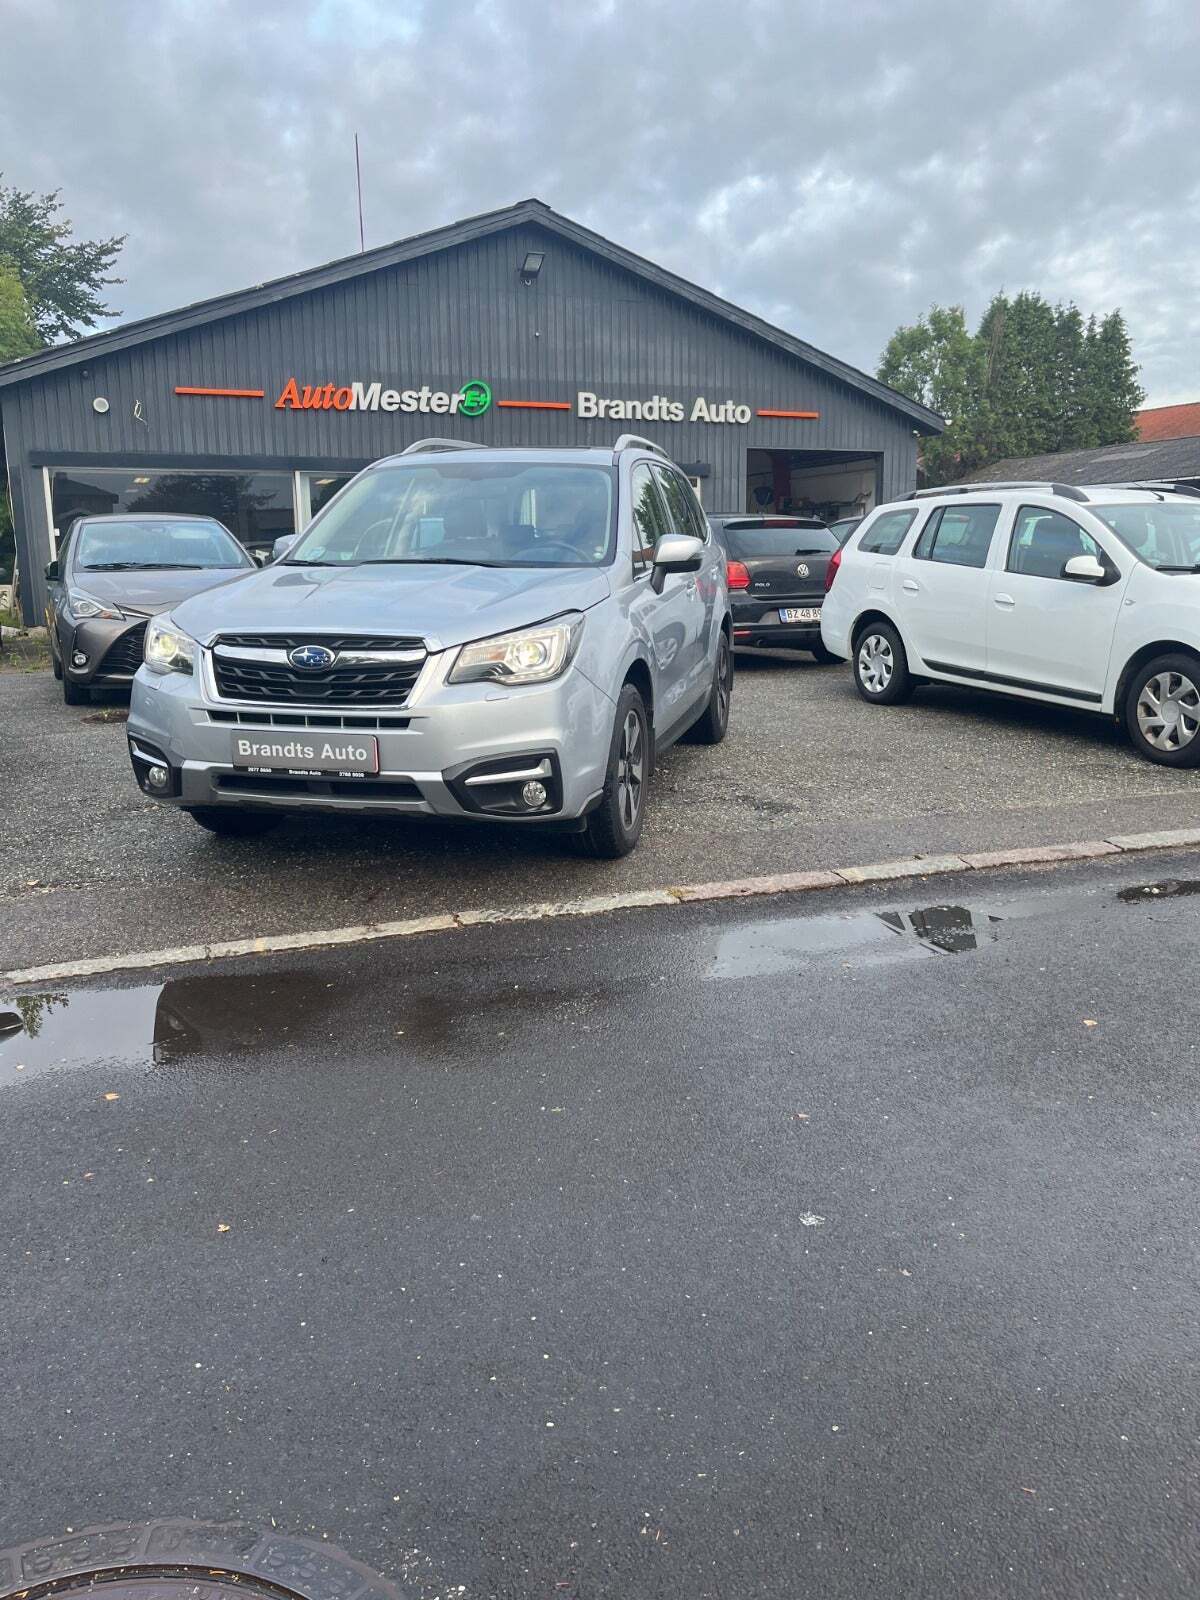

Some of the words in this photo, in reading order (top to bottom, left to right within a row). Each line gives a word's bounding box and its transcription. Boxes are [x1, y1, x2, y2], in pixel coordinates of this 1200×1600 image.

[274, 377, 465, 415] AutoMester
[577, 391, 685, 422] Brandts
[689, 396, 752, 424] Auto
[787, 609, 799, 618] BZ
[801, 608, 811, 618] 48
[238, 740, 313, 759] Brandts
[321, 744, 367, 760] Auto
